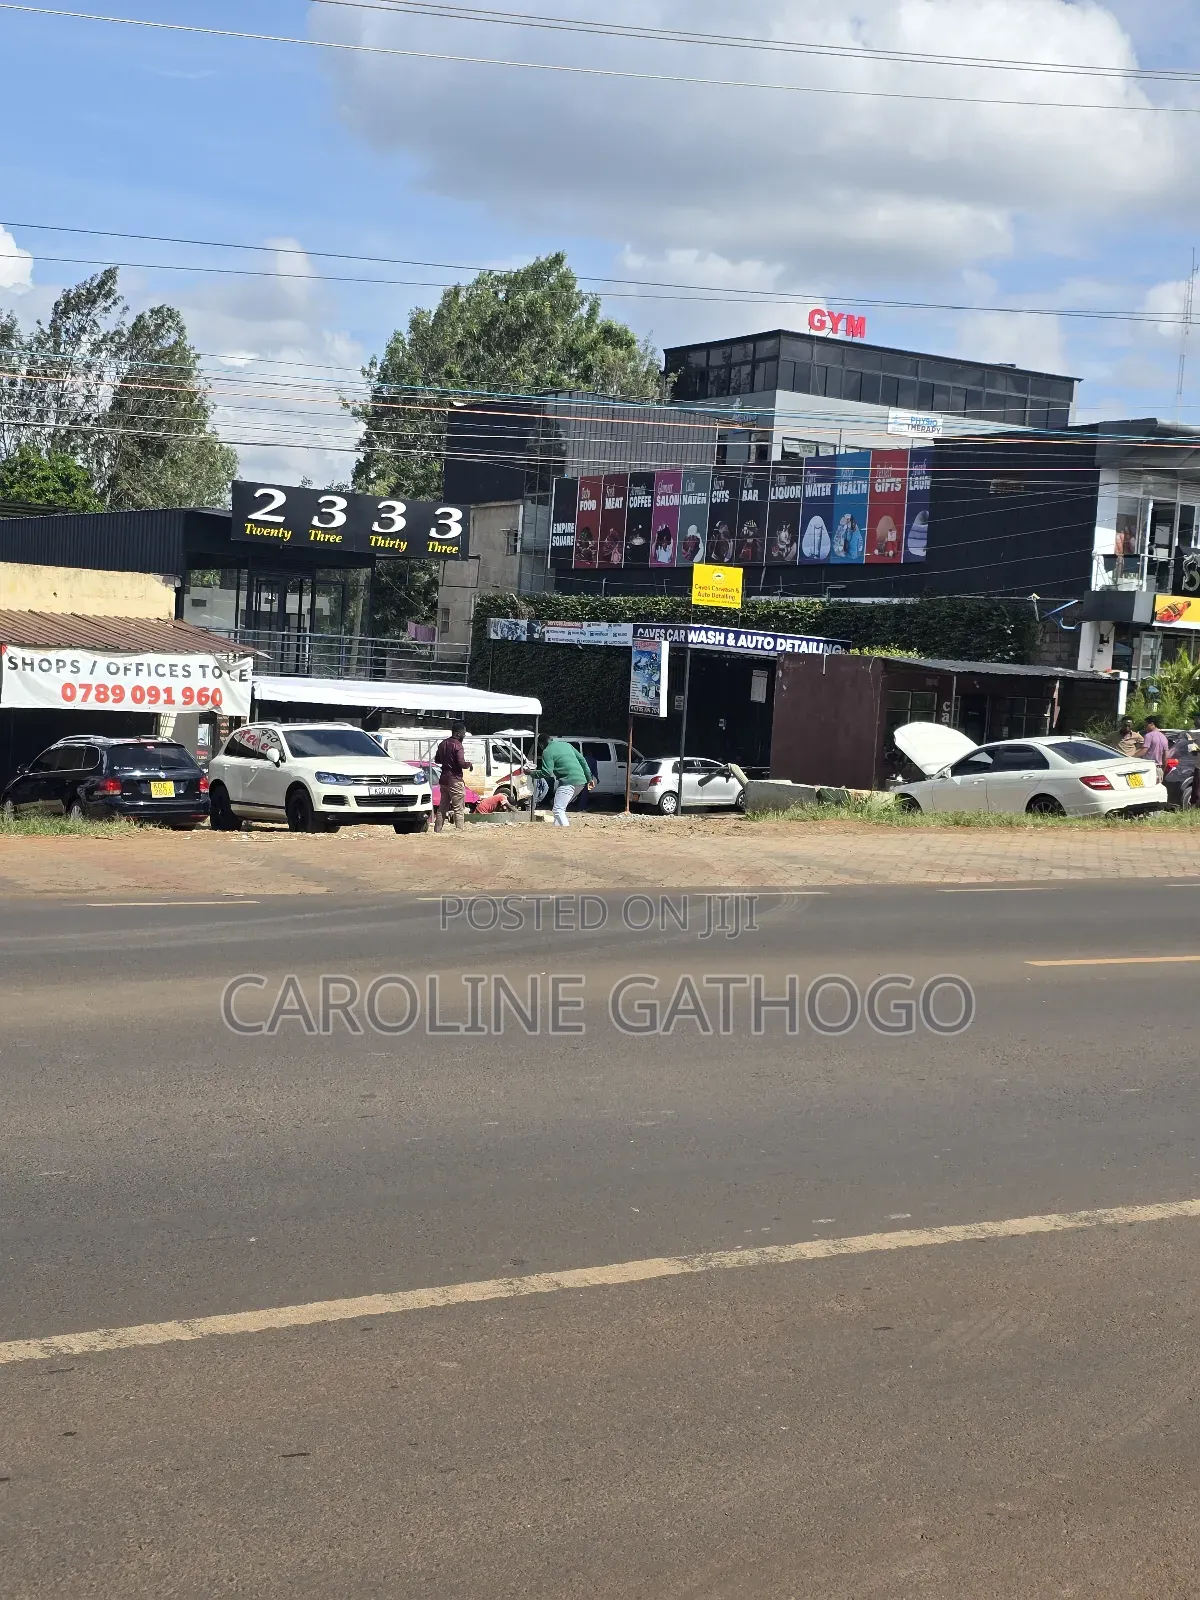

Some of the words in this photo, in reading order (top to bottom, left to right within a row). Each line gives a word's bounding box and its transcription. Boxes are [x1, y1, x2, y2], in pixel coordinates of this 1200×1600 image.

[808, 308, 866, 339] GYM
[907, 424, 941, 434] THERAPY
[910, 416, 938, 427] PHYSIO
[770, 485, 802, 500] LIQUOR
[805, 483, 832, 498] WATER
[837, 480, 868, 496] HEALTH
[874, 478, 902, 493] GIFTS
[629, 495, 652, 509] COFFEE
[655, 494, 680, 507] SALON
[681, 493, 707, 507] HAVEN
[711, 489, 730, 504] CUTS
[741, 489, 759, 502] BAR
[579, 499, 597, 512] FOOD
[604, 497, 624, 510] MEAT
[247, 488, 287, 523] 2
[311, 495, 348, 528] 3
[371, 500, 407, 533] 3
[428, 507, 463, 539] 3
[552, 522, 575, 534] EMPIRE
[244, 522, 292, 541] Twenty
[308, 529, 343, 544] Three
[369, 535, 408, 552] Thirty
[427, 540, 459, 554] Three
[551, 535, 574, 547] SQUARE
[637, 627, 665, 641] CAVES
[666, 629, 686, 642] CAR
[687, 629, 724, 645] WASH
[726, 631, 736, 647] &
[737, 634, 774, 650] AUTO
[776, 637, 842, 655] DETAILING
[7, 655, 81, 675] SHOPS
[88, 660, 98, 675] /
[106, 661, 192, 679] OFFICES
[198, 664, 223, 680] TO
[61, 682, 125, 704] 0789
[131, 684, 176, 705] 091
[181, 686, 223, 707] 960
[941, 701, 951, 726] ca
